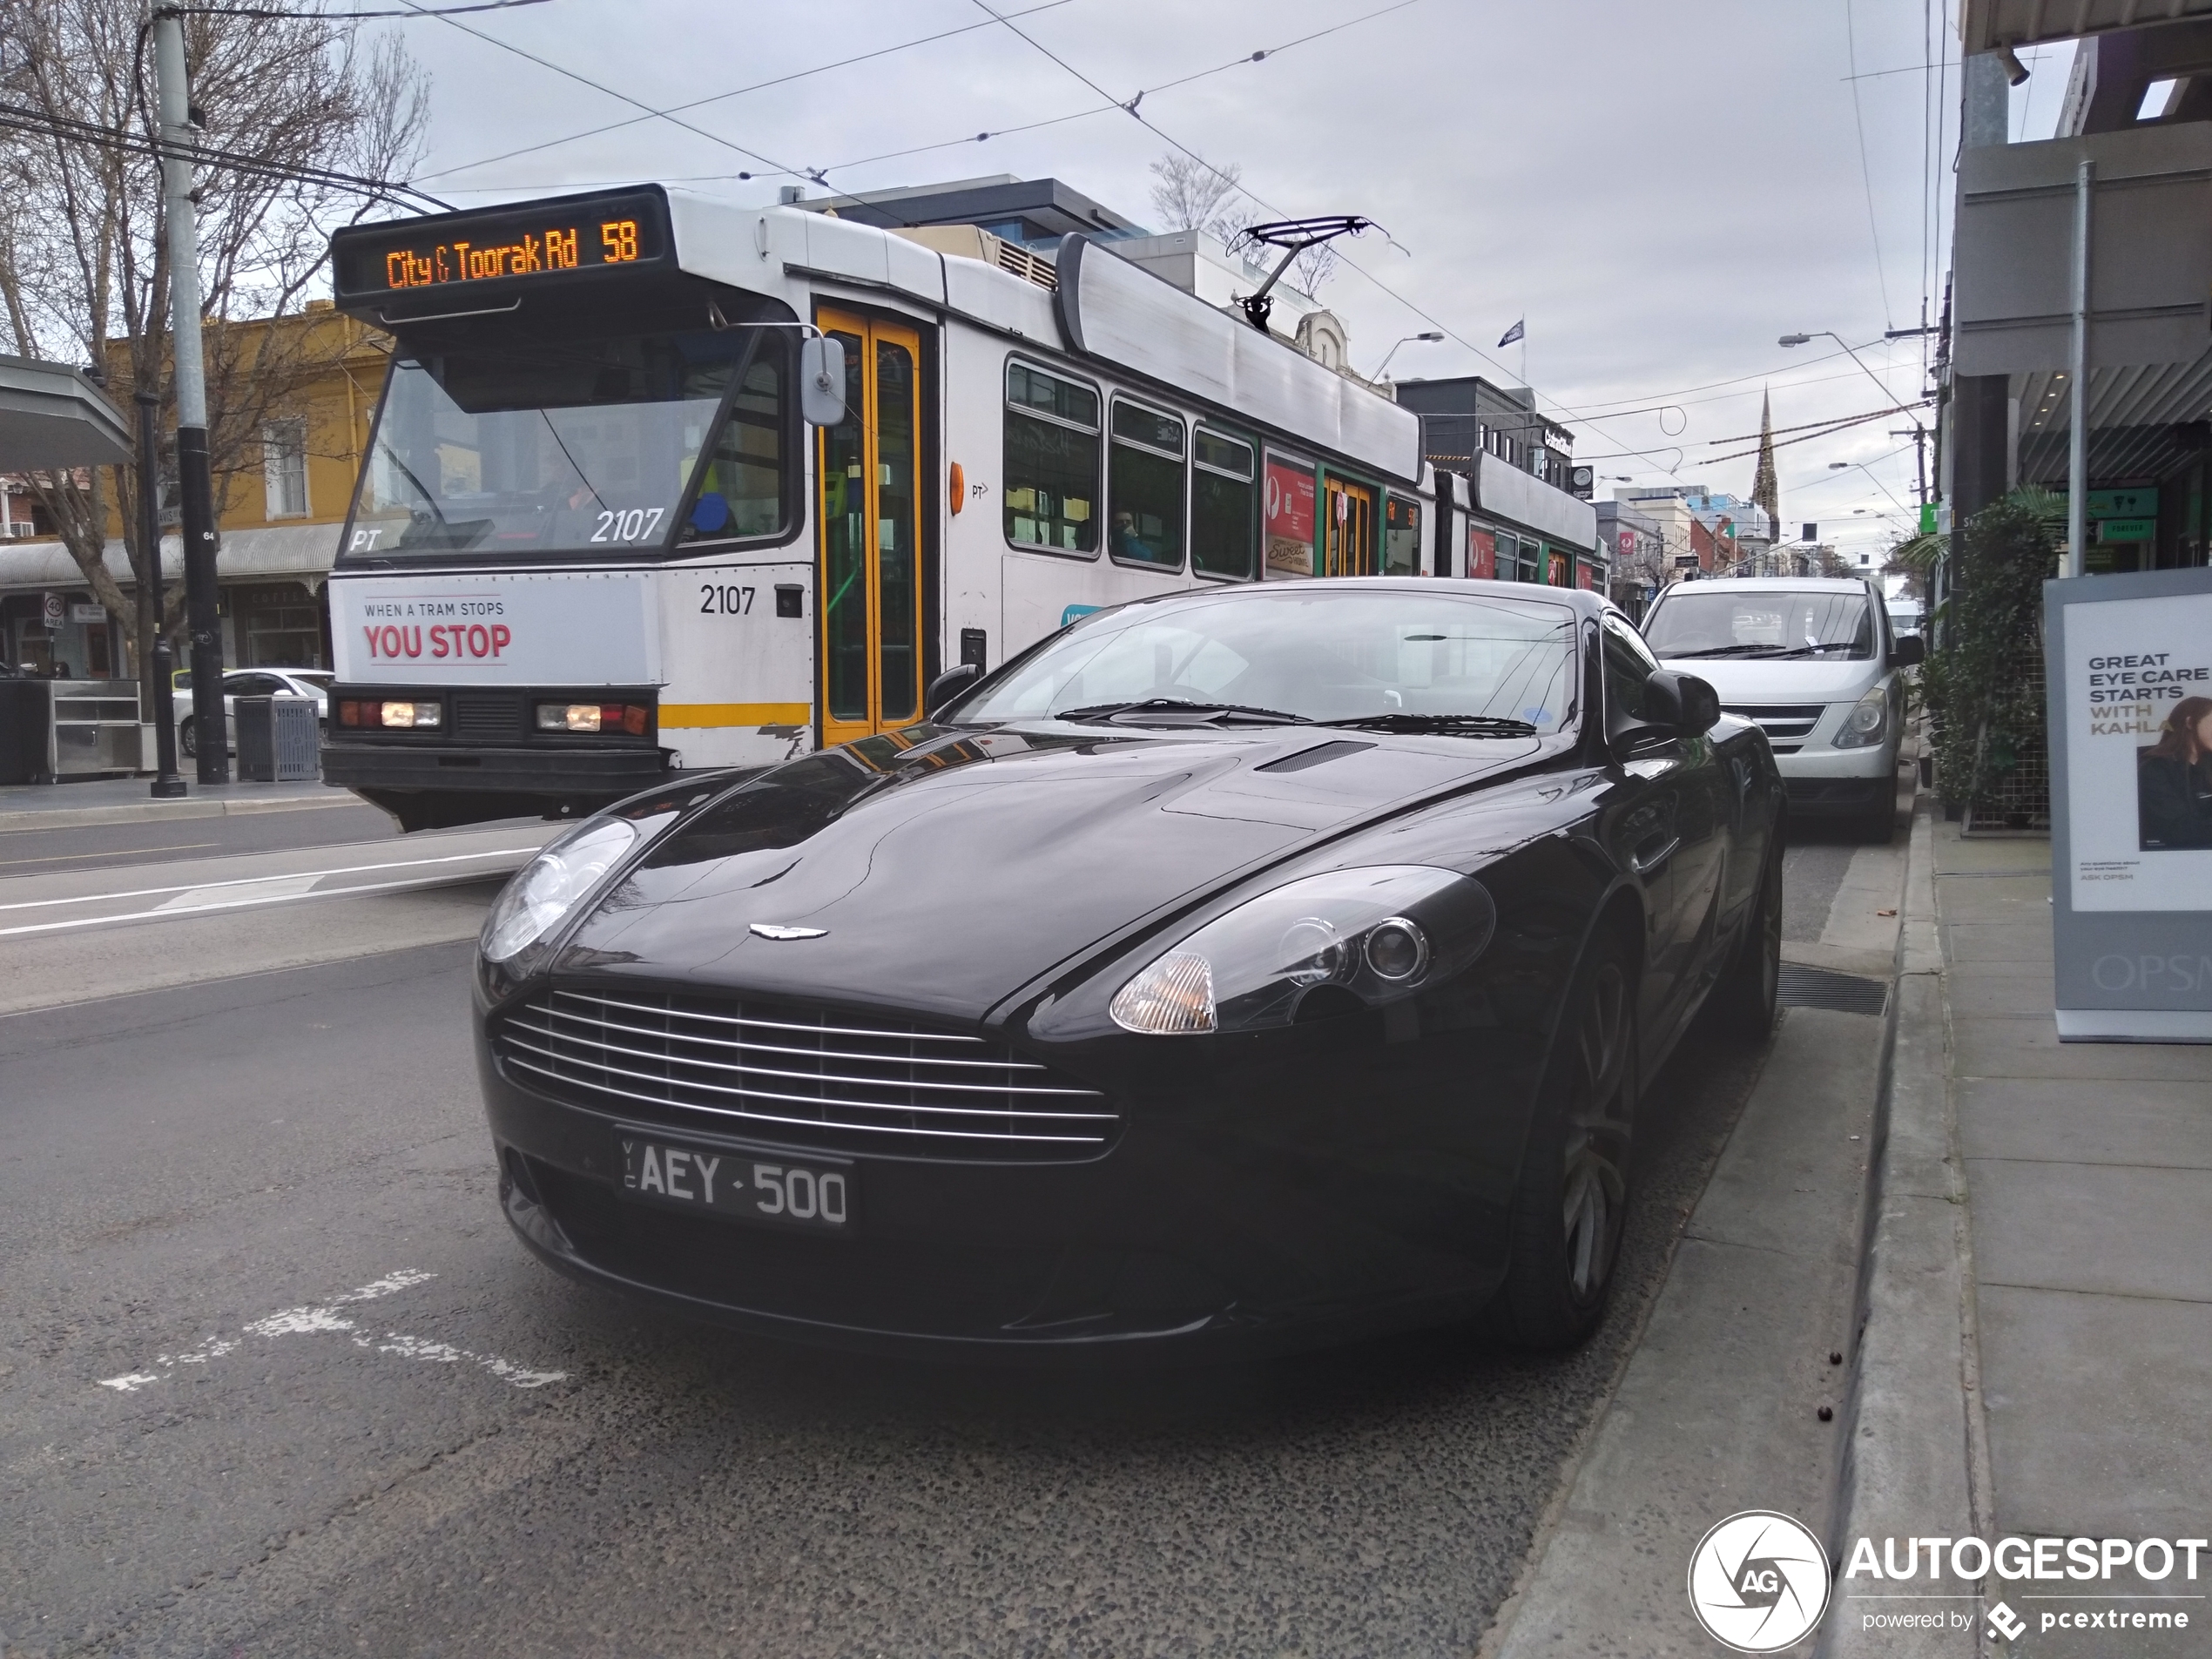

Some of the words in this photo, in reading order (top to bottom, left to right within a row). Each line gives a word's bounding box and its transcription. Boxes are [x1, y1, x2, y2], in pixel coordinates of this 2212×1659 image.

[387, 251, 432, 290] City
[435, 246, 450, 284] &
[454, 235, 540, 281] Toorak
[545, 229, 578, 269] Rd
[602, 221, 638, 263] 58
[159, 510, 173, 523] AVIS
[590, 508, 664, 543] 2107
[203, 531, 214, 541] 64
[2112, 524, 2143, 533] FOREVER
[349, 529, 381, 552] PT
[1268, 543, 1305, 560] Sweet
[48, 602, 61, 612] 40
[700, 584, 755, 615] 2107
[365, 601, 402, 617] WHEN
[407, 601, 415, 617] A
[420, 601, 455, 617] TRAM
[461, 601, 504, 616] STOPS
[45, 618, 64, 627] AREA
[363, 624, 422, 659] YOU
[430, 624, 511, 658] STOP
[2088, 652, 2170, 671] GREAT
[2089, 671, 2138, 687] EYE
[2141, 667, 2209, 685] CARE
[2089, 686, 2184, 703] STARTS
[2090, 704, 2152, 719] WITH
[2090, 718, 2175, 736] KAHLA
[622, 1141, 637, 1188] VIC
[640, 1145, 720, 1204] AEY
[753, 1163, 846, 1224] 500
